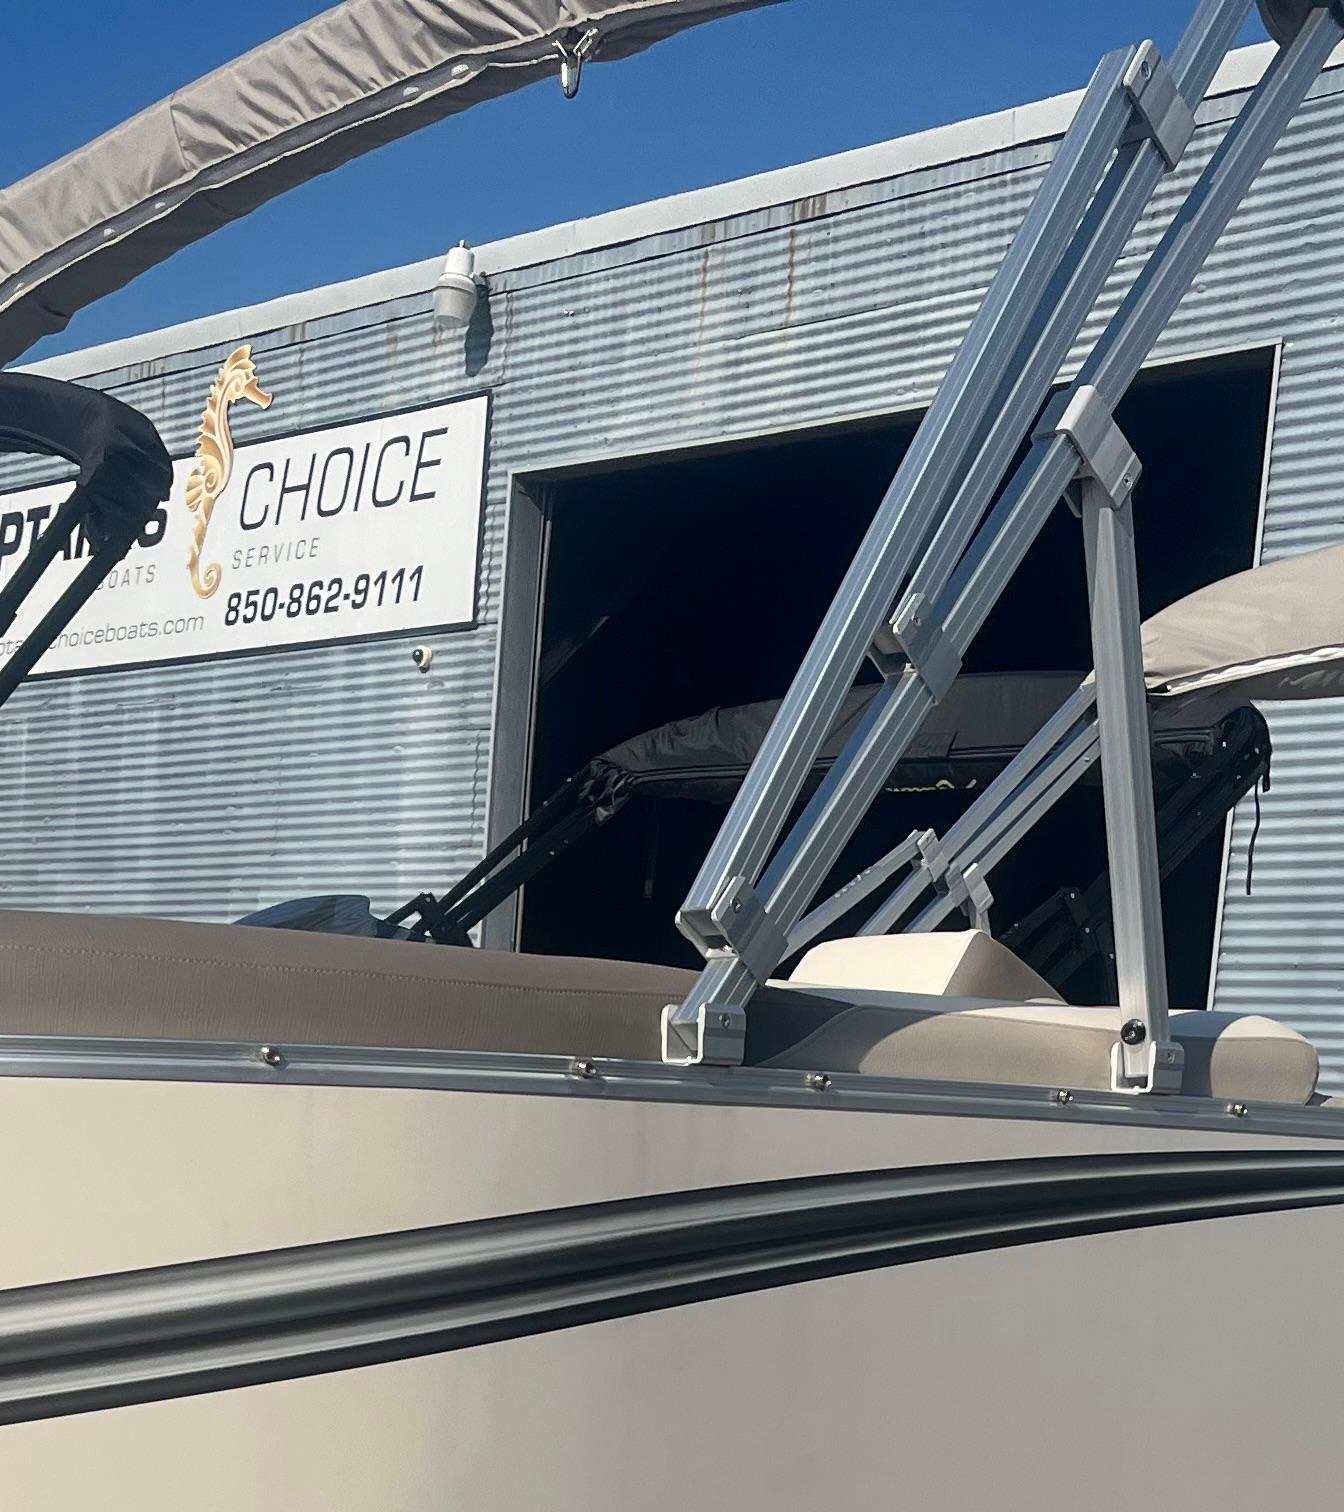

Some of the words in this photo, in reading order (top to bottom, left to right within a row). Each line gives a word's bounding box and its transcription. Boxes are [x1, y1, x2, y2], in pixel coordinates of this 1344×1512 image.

[239, 427, 449, 531] CHOICE
[96, 564, 157, 591] OATS
[231, 537, 321, 569] SERVICE
[224, 565, 424, 626] 850-862-9111
